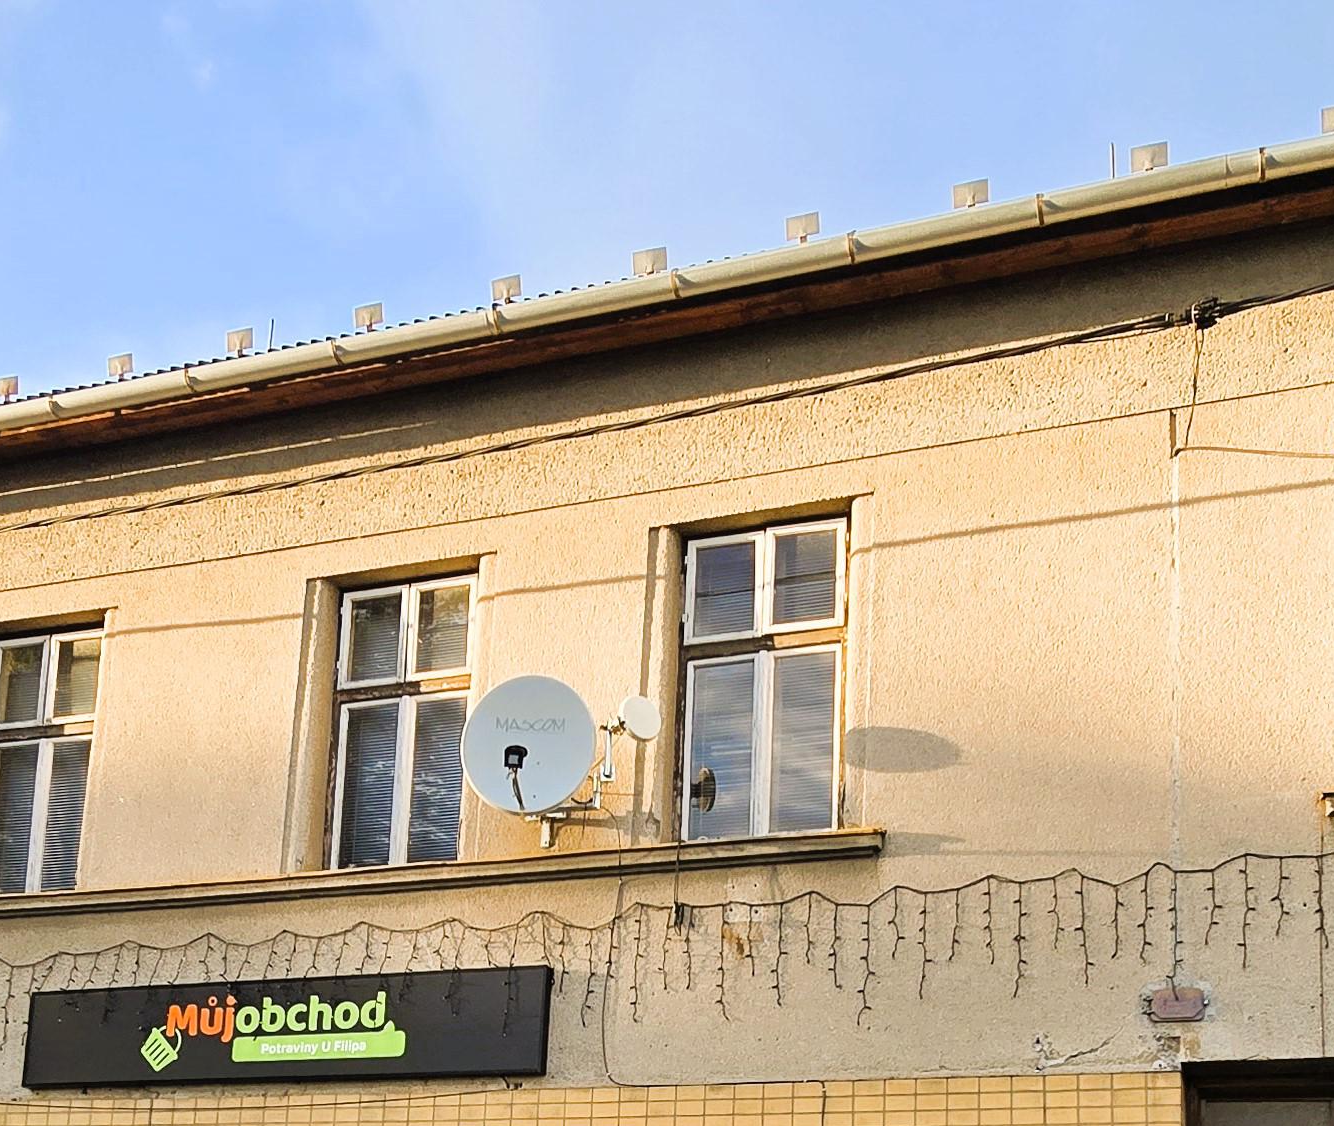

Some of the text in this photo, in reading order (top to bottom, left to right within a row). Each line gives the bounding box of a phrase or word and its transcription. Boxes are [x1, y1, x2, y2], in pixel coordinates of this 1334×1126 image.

[495, 716, 566, 732] MASCOM
[260, 1039, 367, 1055] Potraviny U Filipa
